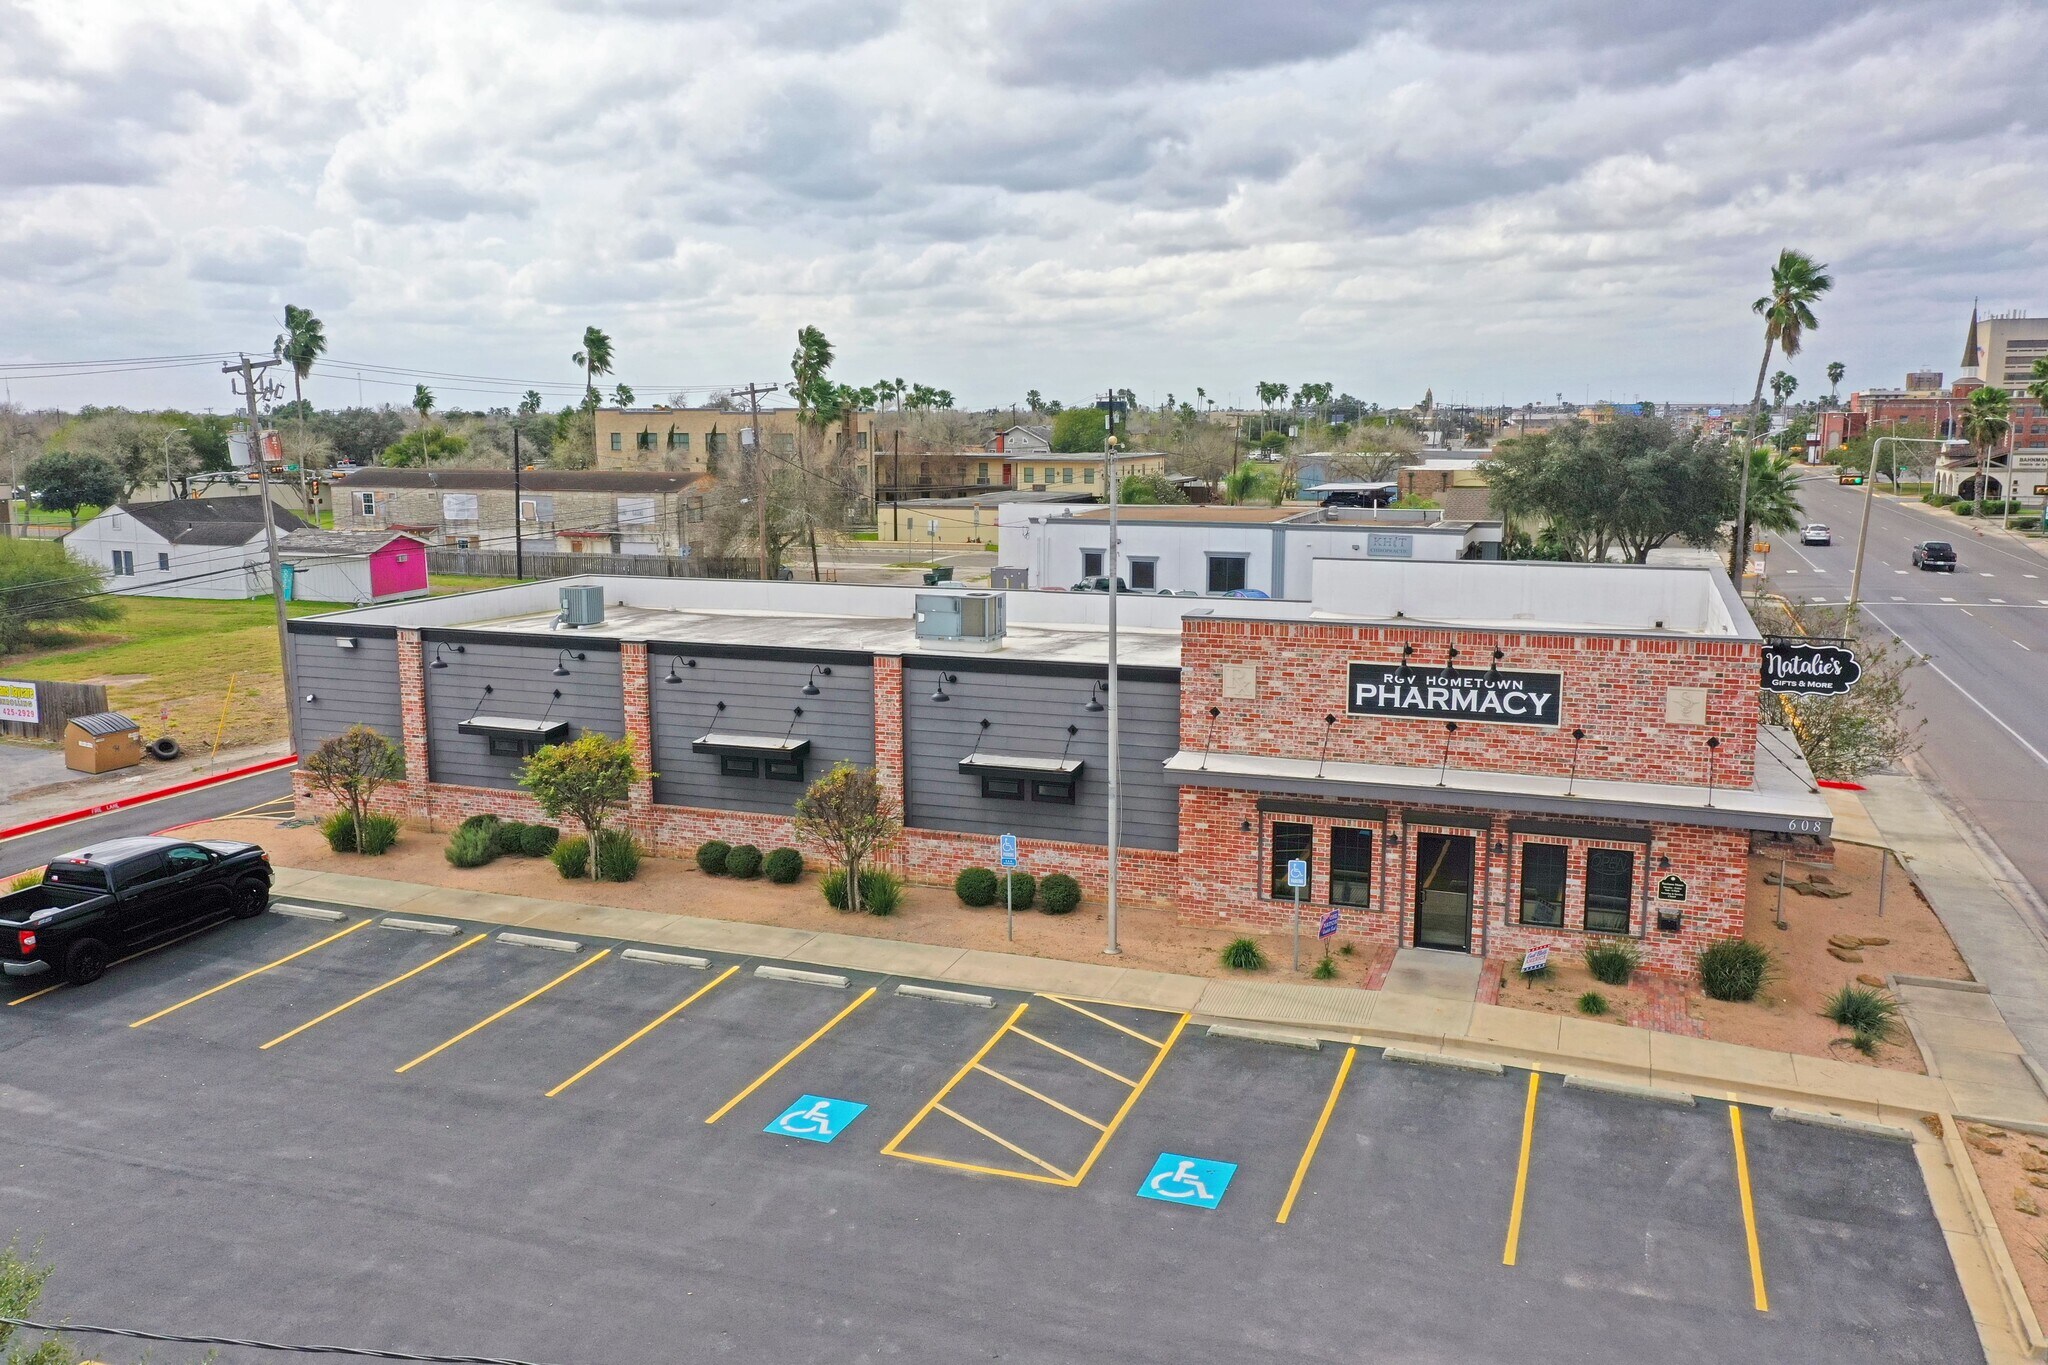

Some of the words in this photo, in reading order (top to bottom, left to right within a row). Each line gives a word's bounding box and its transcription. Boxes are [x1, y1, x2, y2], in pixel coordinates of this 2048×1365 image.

[1766, 653, 1842, 678] Natalie's
[1384, 674, 1416, 685] RGV
[1426, 676, 1523, 690] HOMETOWN
[1807, 681, 1833, 689] MORE
[10, 685, 35, 699] Daycare
[1356, 684, 1551, 716] PHARMACY
[3, 708, 35, 717] 425-2929
[106, 802, 120, 811] LANE
[1788, 819, 1822, 832] 608
[1592, 855, 1628, 871] OPEN
